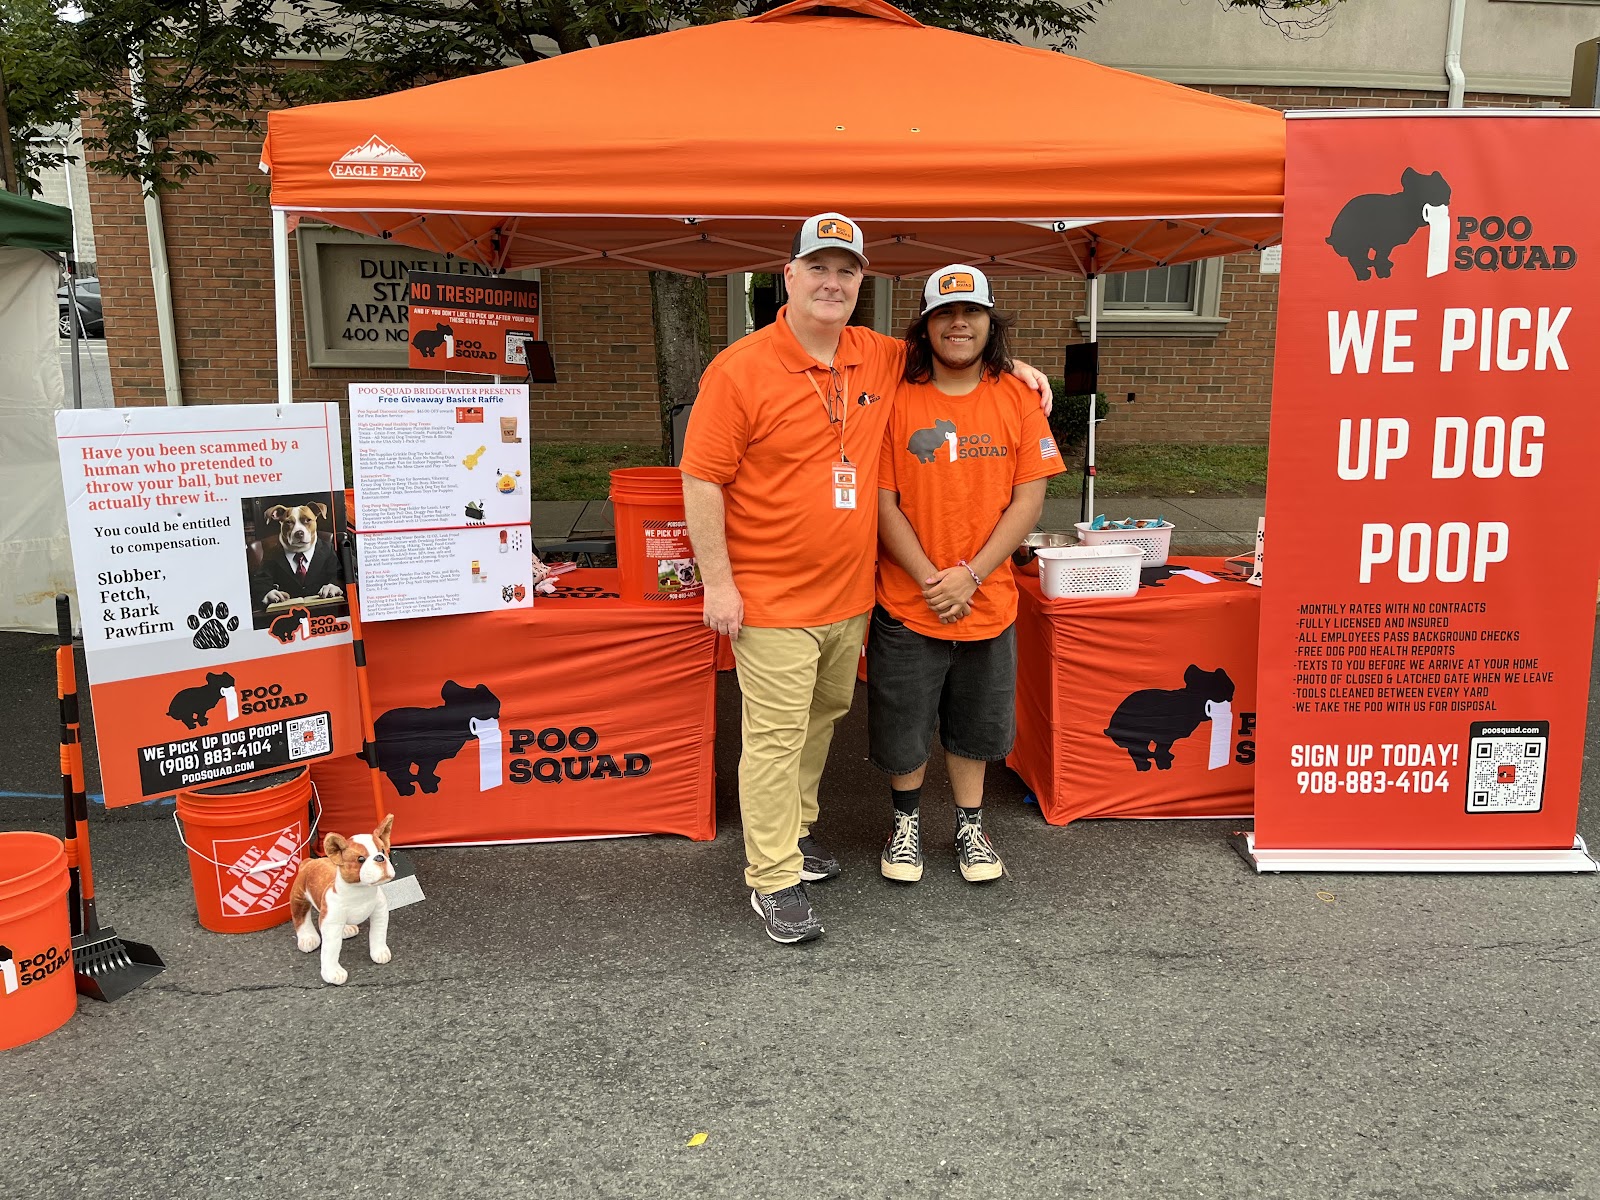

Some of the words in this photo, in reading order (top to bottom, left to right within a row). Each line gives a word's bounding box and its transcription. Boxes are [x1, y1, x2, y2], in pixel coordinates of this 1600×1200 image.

[334, 166, 379, 178] EAGLE
[383, 167, 418, 177] PEAK
[1457, 216, 1532, 242] POO
[1454, 246, 1577, 272] SQUAD
[411, 283, 430, 300] NO
[436, 285, 536, 308] TRESPOOPING
[342, 327, 379, 342] 400
[1328, 309, 1417, 374] WE
[1440, 307, 1572, 372] PICK
[456, 340, 482, 349] POO
[456, 350, 497, 360] SQUAD
[402, 396, 444, 404] Giveaway
[82, 448, 122, 460] Have
[127, 448, 155, 460] you
[160, 443, 196, 456] been
[200, 439, 267, 454] scammed
[272, 438, 286, 453] by
[292, 440, 298, 449] a
[959, 434, 990, 446] POO
[1338, 418, 1409, 480] UP
[1432, 416, 1544, 478] DOG
[958, 445, 1008, 459] SQUAD
[84, 464, 140, 477] human
[144, 460, 176, 473] who
[180, 456, 255, 475] pretended
[259, 456, 273, 466] to
[86, 480, 133, 494] throw
[138, 480, 174, 493] your
[178, 475, 211, 488] ball,
[215, 474, 238, 486] but
[244, 472, 282, 484] never
[89, 494, 150, 510] actually
[156, 493, 200, 506] threw
[204, 491, 228, 502] it...
[94, 527, 120, 537] You
[125, 522, 160, 534] could
[164, 522, 178, 531] be
[183, 516, 230, 529] entitled
[111, 546, 123, 554] to
[128, 536, 219, 553] compensation.
[1360, 522, 1508, 583] POOP
[98, 569, 165, 585] Slobber,
[100, 587, 150, 603] Fetch,
[103, 609, 116, 621] &
[120, 603, 159, 619] Bark
[1298, 604, 1346, 614] -MONTHLY
[1350, 604, 1381, 614] RATES
[1386, 604, 1409, 613] WITH
[1413, 603, 1425, 613] NO
[1429, 603, 1486, 613] CONTRACTS
[104, 622, 174, 639] Pawfirm
[310, 618, 334, 628] POO
[310, 622, 348, 635] SQUAD
[1296, 618, 1330, 628] -FULLY
[1334, 618, 1380, 628] LICENSED
[1385, 618, 1404, 628] AND
[1408, 617, 1448, 628] INSURED
[1296, 632, 1317, 642] -ALL
[1322, 632, 1380, 642] EMPLOYEES
[1384, 632, 1409, 642] PASS
[1413, 631, 1477, 641] BACKGROUND
[1481, 631, 1519, 641] CHECKS
[1295, 646, 1322, 656] -FREE
[1326, 646, 1344, 656] DOG
[1348, 646, 1366, 656] POO
[1370, 646, 1408, 656] HEALTH
[1412, 646, 1454, 655] REPORTS
[1294, 660, 1327, 670] -TEXTS
[1332, 660, 1342, 670] TO
[1347, 660, 1365, 670] YOU
[1369, 660, 1406, 670] BEFORE
[1410, 660, 1424, 670] WE
[1429, 660, 1464, 669] ARRIVE
[1468, 659, 1480, 669] AT
[1484, 659, 1509, 669] YOUR
[1513, 659, 1538, 669] HOME
[1294, 674, 1326, 684] -PHOTO
[1331, 674, 1342, 684] OF
[1346, 674, 1382, 684] CLOSED
[1387, 674, 1392, 684] &
[1397, 674, 1440, 684] LATCHED
[1444, 674, 1469, 683] GATE
[1474, 673, 1500, 683] WHEN
[1505, 673, 1520, 683] WE
[1524, 672, 1553, 682] LEAVE
[240, 684, 282, 702] POO
[1293, 688, 1326, 698] -TOOLS
[1330, 688, 1374, 698] CLEANED
[1378, 688, 1424, 698] BETWEEN
[1428, 688, 1459, 698] EVERY
[1464, 687, 1488, 697] YARD
[242, 693, 308, 716] SQUAD
[1293, 702, 1310, 712] -WE
[1315, 702, 1339, 712] TAKE
[1344, 702, 1360, 712] THE
[1365, 702, 1382, 712] POO
[1387, 702, 1410, 712] WITH
[1414, 702, 1425, 711] US
[1430, 702, 1448, 711] FOR
[1451, 701, 1496, 711] DISPOSAL
[1482, 726, 1539, 735] poosquad.com
[144, 747, 165, 761] WE
[169, 740, 198, 756] PICK
[202, 737, 218, 749] UP
[222, 731, 245, 745] DOG
[249, 722, 282, 740] POOP!
[510, 727, 598, 754] POO
[160, 754, 199, 776] (908)
[204, 739, 271, 765] 883-4104
[1291, 745, 1338, 766] SIGN
[1347, 745, 1373, 766] UP
[1382, 744, 1458, 766] TODAY!
[510, 754, 652, 784] SQUAD
[1298, 771, 1449, 793] 908-883-4104
[222, 828, 300, 914] HOME
[226, 846, 265, 878] THE
[257, 851, 301, 910] DEPOT
[19, 947, 56, 972] POO
[21, 948, 70, 986] SQUAD
